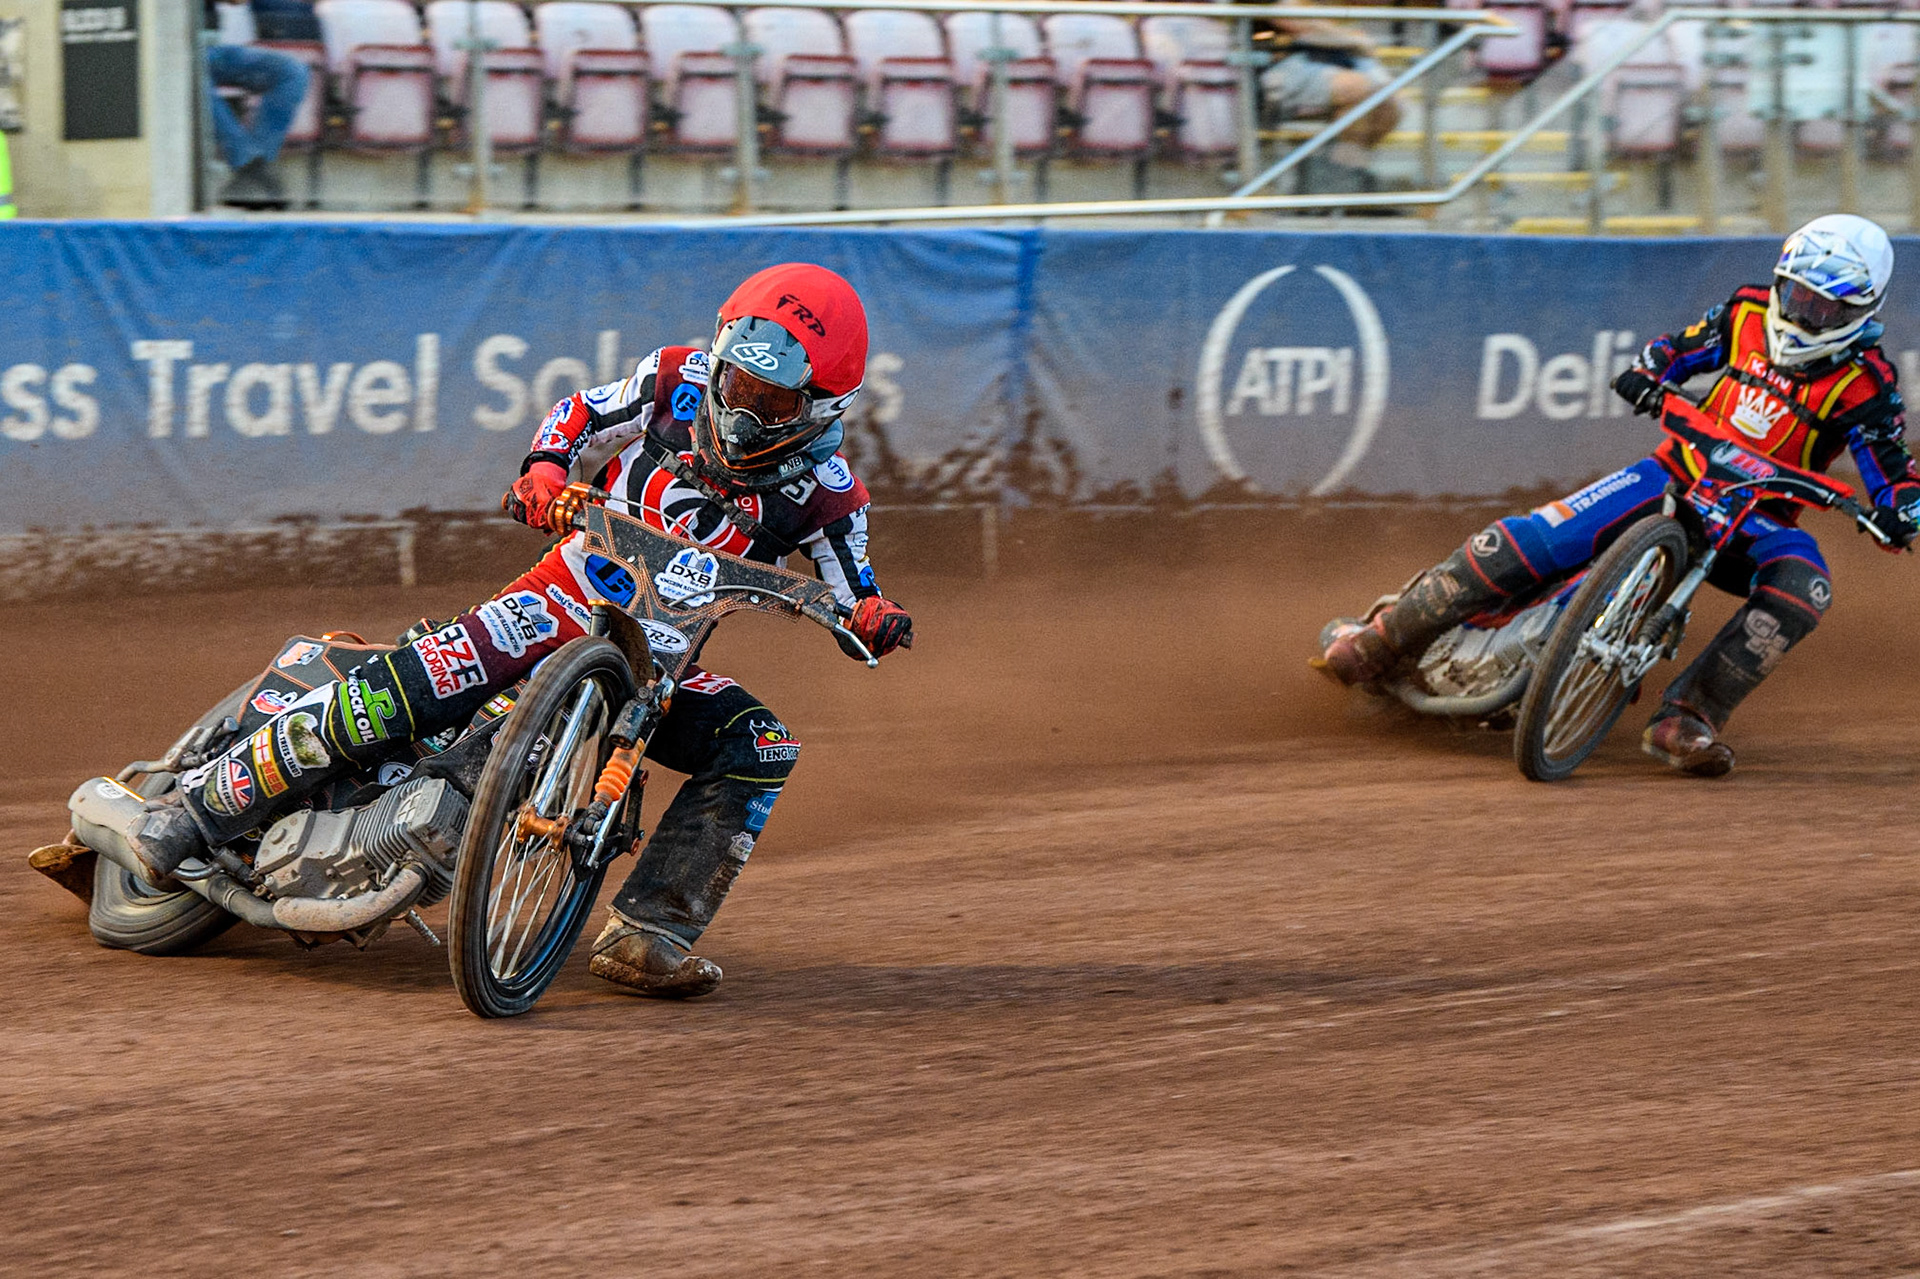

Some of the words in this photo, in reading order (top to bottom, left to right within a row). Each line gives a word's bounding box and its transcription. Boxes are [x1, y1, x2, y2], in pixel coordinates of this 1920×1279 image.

[776, 294, 826, 337] FRP
[131, 333, 440, 438] Travel
[689, 357, 710, 373] DX
[1227, 346, 1353, 416] ATPI
[1572, 471, 1642, 513] TRAINING
[670, 564, 711, 586] DXB
[502, 597, 538, 641] DXB
[417, 637, 455, 696] SHORING
[347, 675, 365, 717] ROCK
[355, 717, 377, 743] OIL
